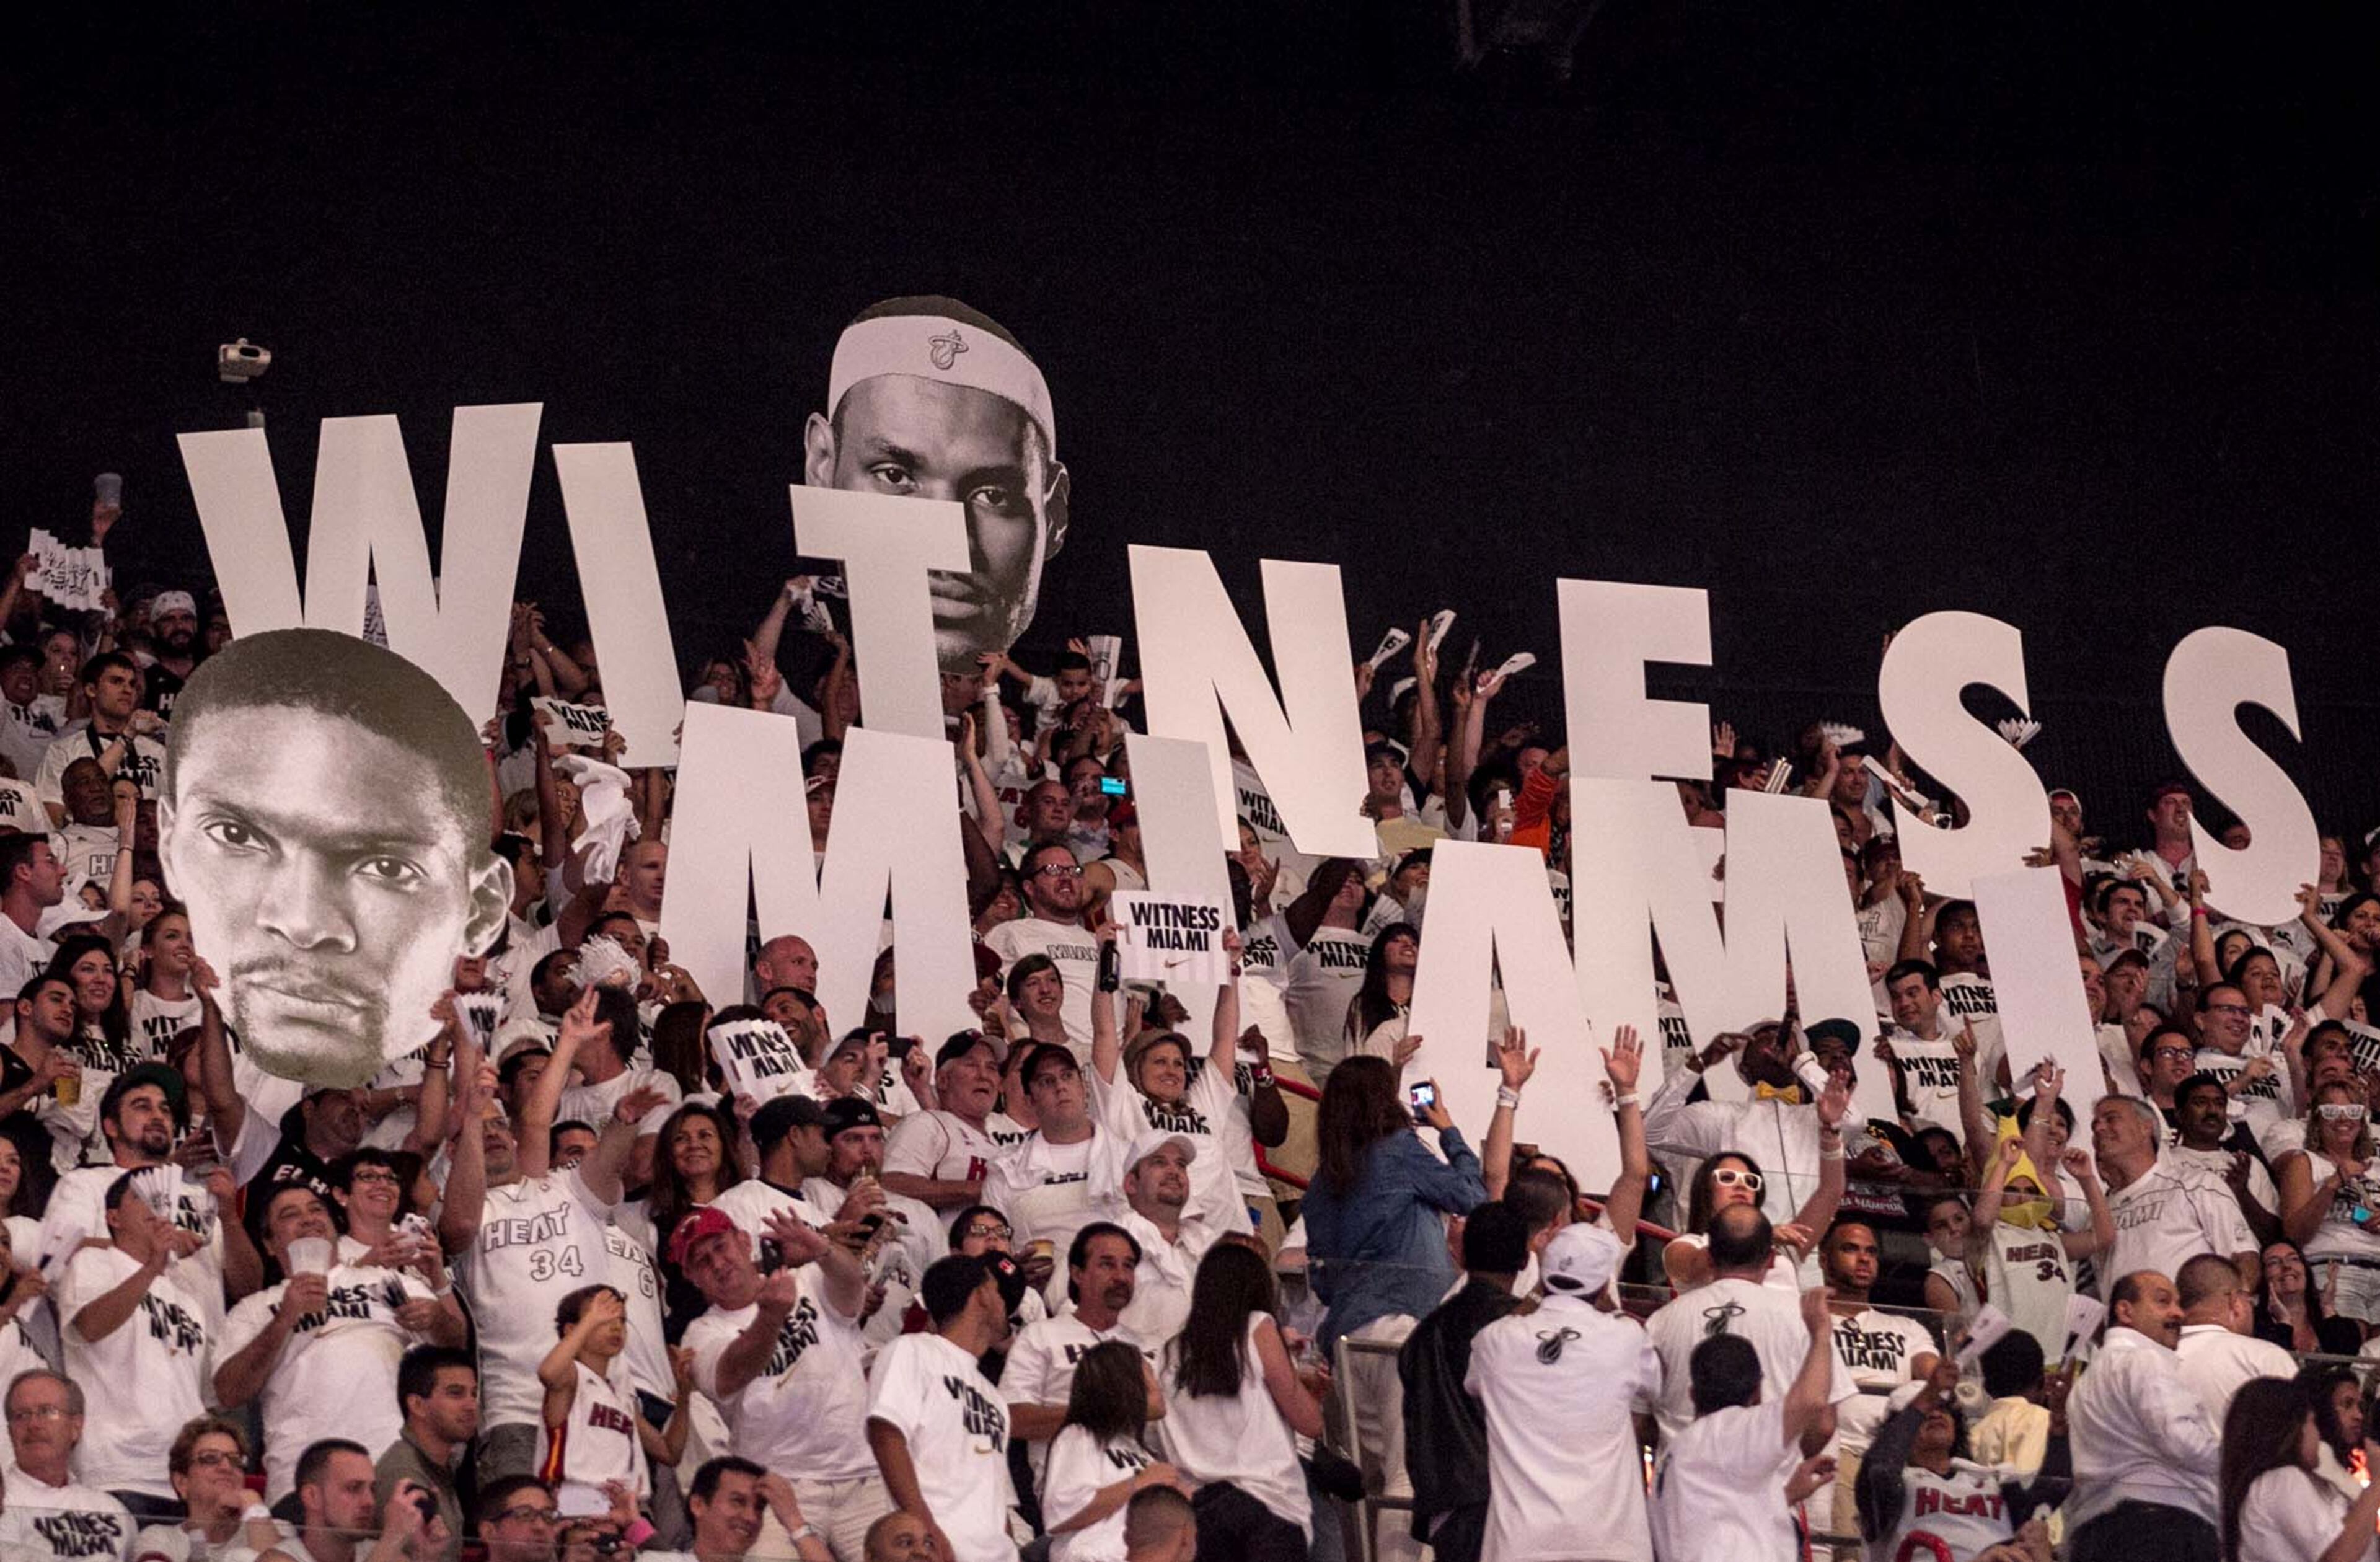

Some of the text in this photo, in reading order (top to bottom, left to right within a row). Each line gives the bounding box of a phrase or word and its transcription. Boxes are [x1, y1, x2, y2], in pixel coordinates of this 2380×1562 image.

[177, 402, 2320, 926] WITNESS
[547, 701, 608, 722] WITNE
[1130, 902, 1219, 932] WITNESS
[659, 702, 2106, 1195] MIAMI
[1146, 928, 1209, 951] MIAMI
[1306, 940, 1371, 956] WITNE
[1897, 1056, 1959, 1072] WITNE
[483, 1201, 570, 1253] HEAT
[2116, 1201, 2165, 1230] AMI
[530, 1245, 584, 1282] 34
[1833, 1329, 1906, 1358] ITNESS
[1915, 1487, 2003, 1520] HEAT
